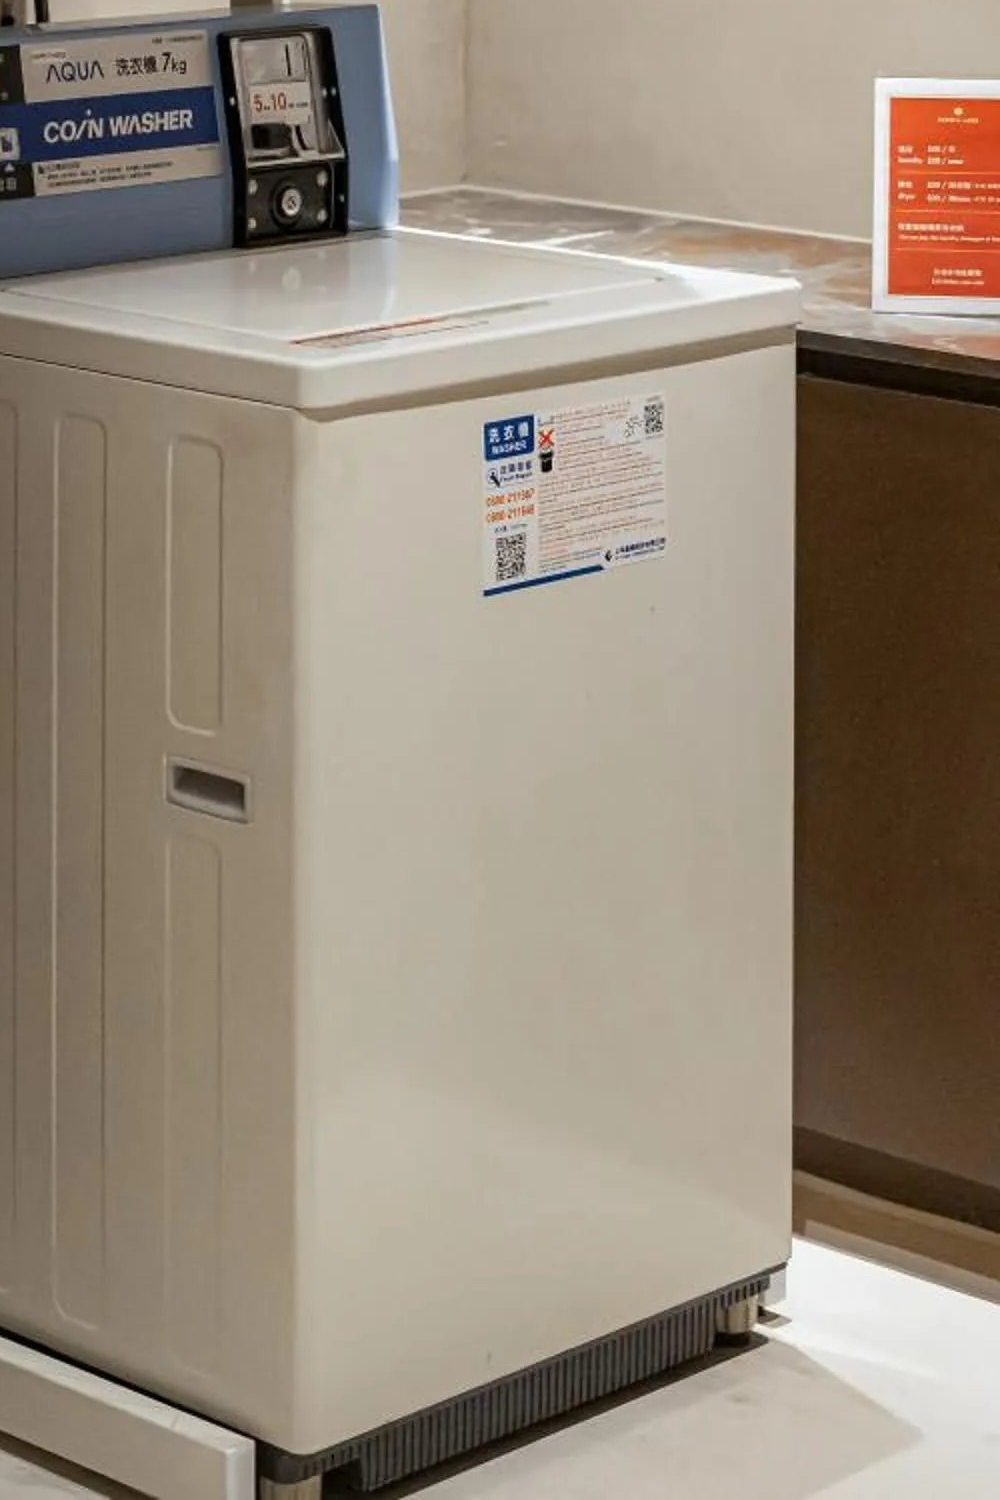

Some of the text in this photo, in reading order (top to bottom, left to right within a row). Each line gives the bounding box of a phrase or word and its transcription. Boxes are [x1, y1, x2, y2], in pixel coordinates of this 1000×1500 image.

[115, 55, 158, 77] 洗衣機
[161, 51, 188, 75] 7kg
[109, 109, 194, 137] WASHER
